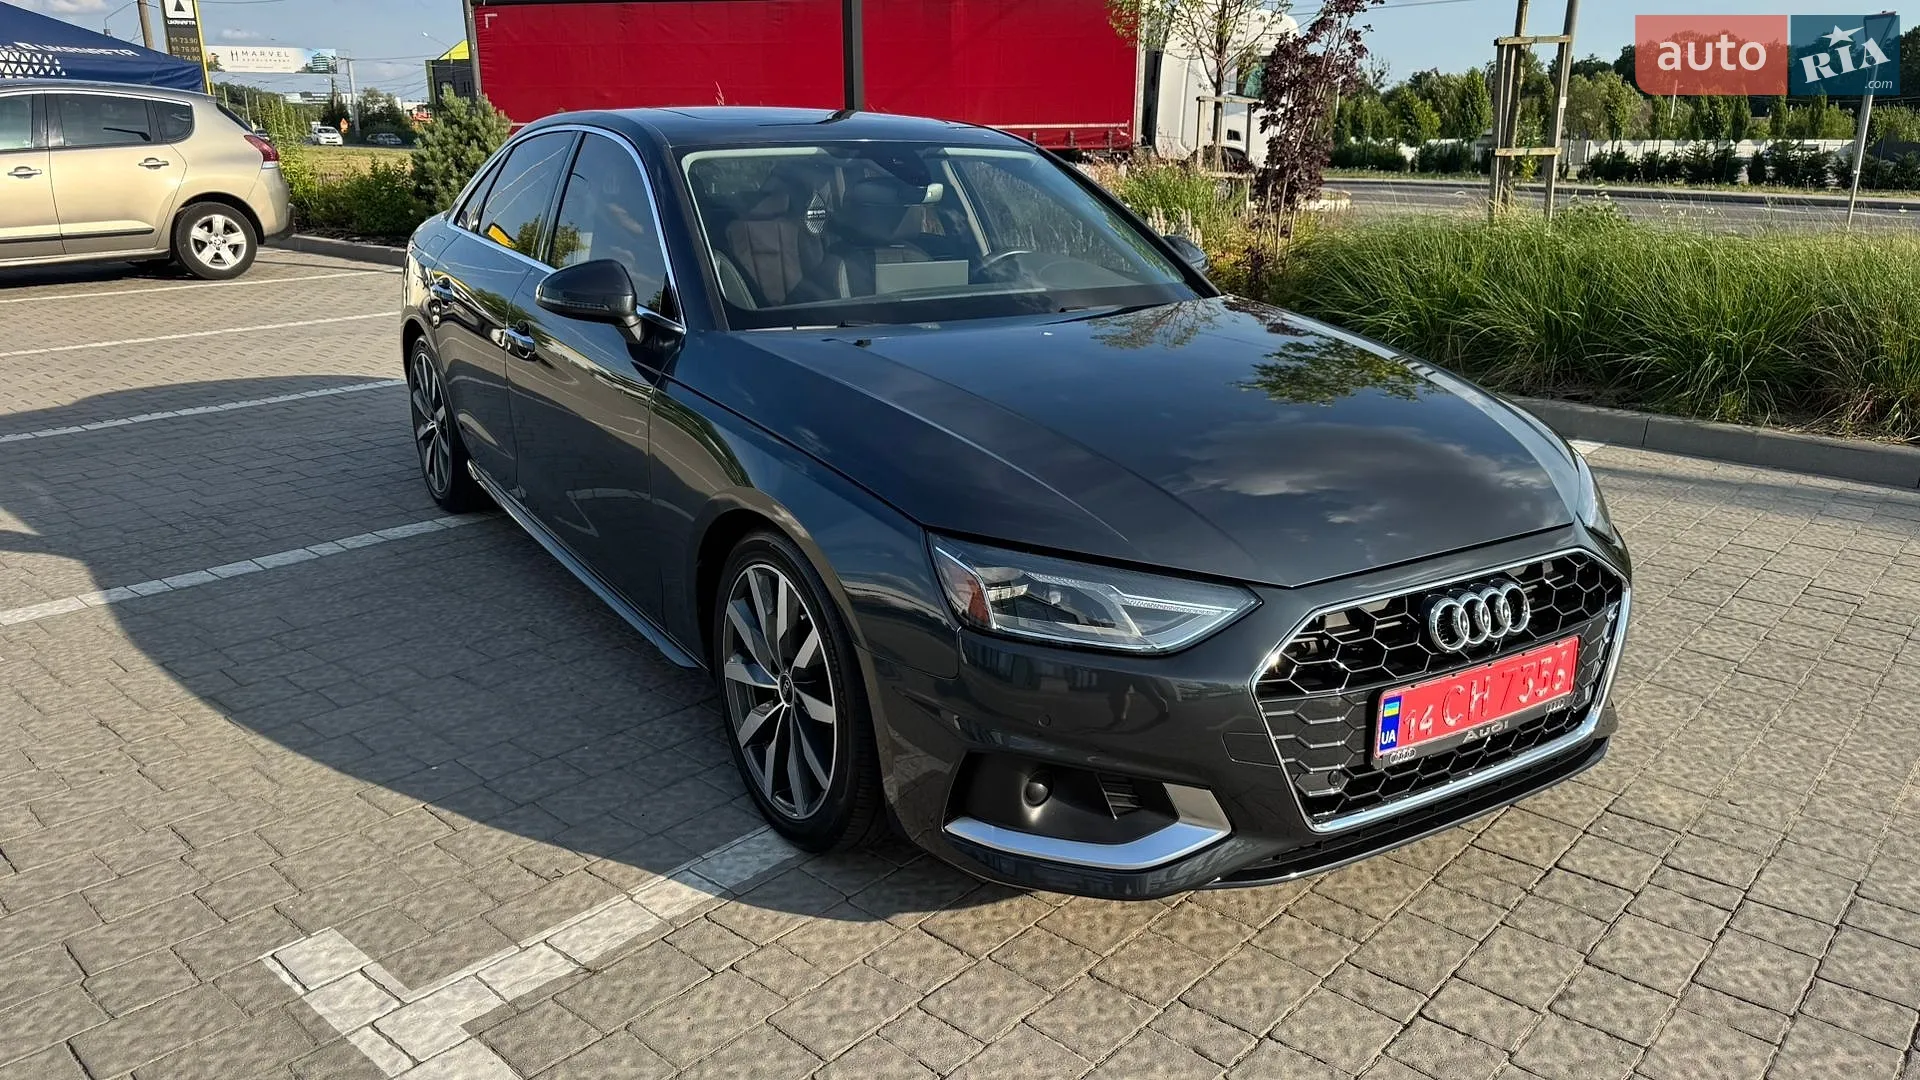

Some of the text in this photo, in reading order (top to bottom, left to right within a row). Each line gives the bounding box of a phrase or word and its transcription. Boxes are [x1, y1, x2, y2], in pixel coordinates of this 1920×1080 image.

[1403, 703, 1434, 740] 14
[1443, 675, 1492, 726] CH
[1381, 728, 1397, 745] UA
